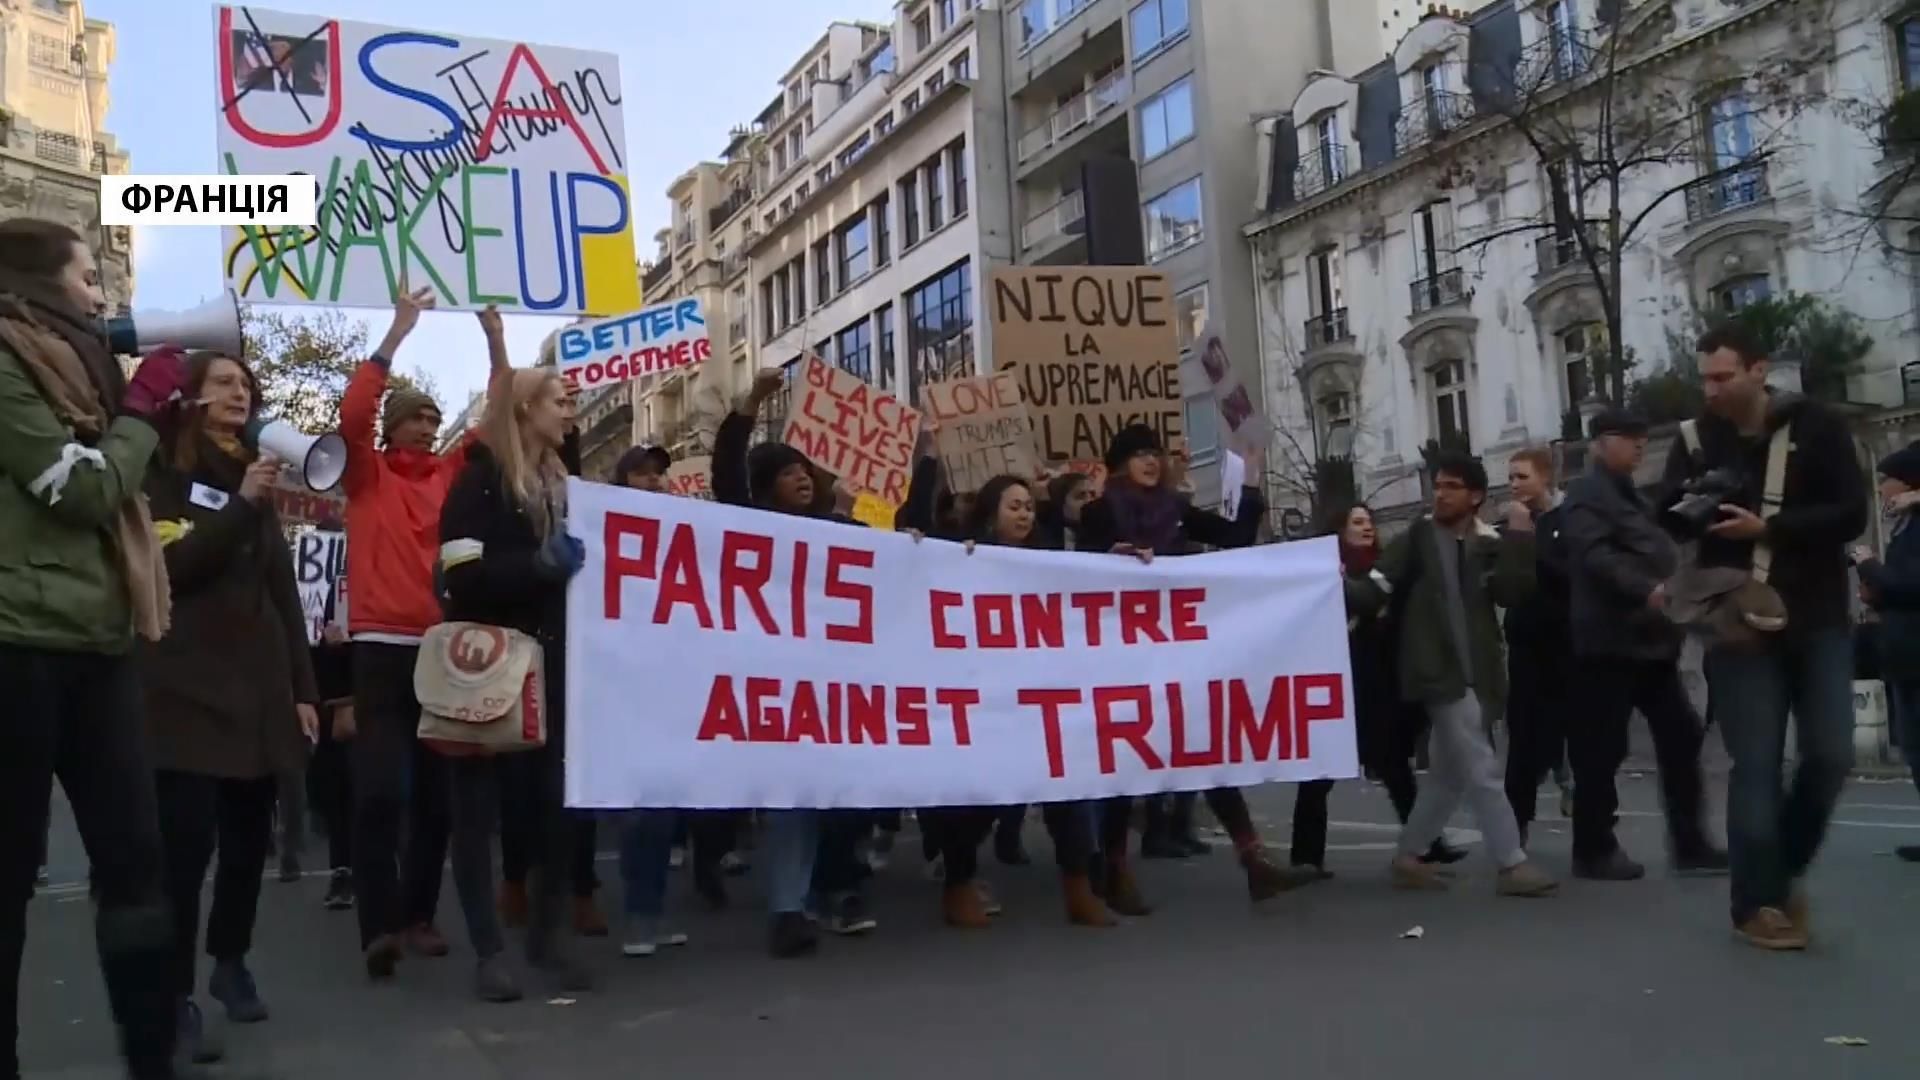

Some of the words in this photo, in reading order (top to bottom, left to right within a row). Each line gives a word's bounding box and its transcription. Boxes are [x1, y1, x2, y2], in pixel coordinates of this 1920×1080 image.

[219, 6, 612, 176] USA
[223, 151, 519, 307] WAKE
[511, 168, 631, 311] UP
[560, 298, 704, 360] BETTER
[994, 274, 1167, 328] NIQUE
[563, 338, 712, 383] TOGETHER
[1064, 332, 1101, 356] LA
[803, 390, 912, 467] LIVES
[807, 356, 917, 443] BLACK
[927, 373, 1017, 420] LOVE
[784, 424, 907, 505] MATTER
[1027, 410, 1183, 462] LANE
[604, 511, 875, 645] PARIS
[930, 588, 1208, 650] CONTRE
[698, 675, 980, 746] AGAINST
[1017, 673, 1345, 778] TRUMP
